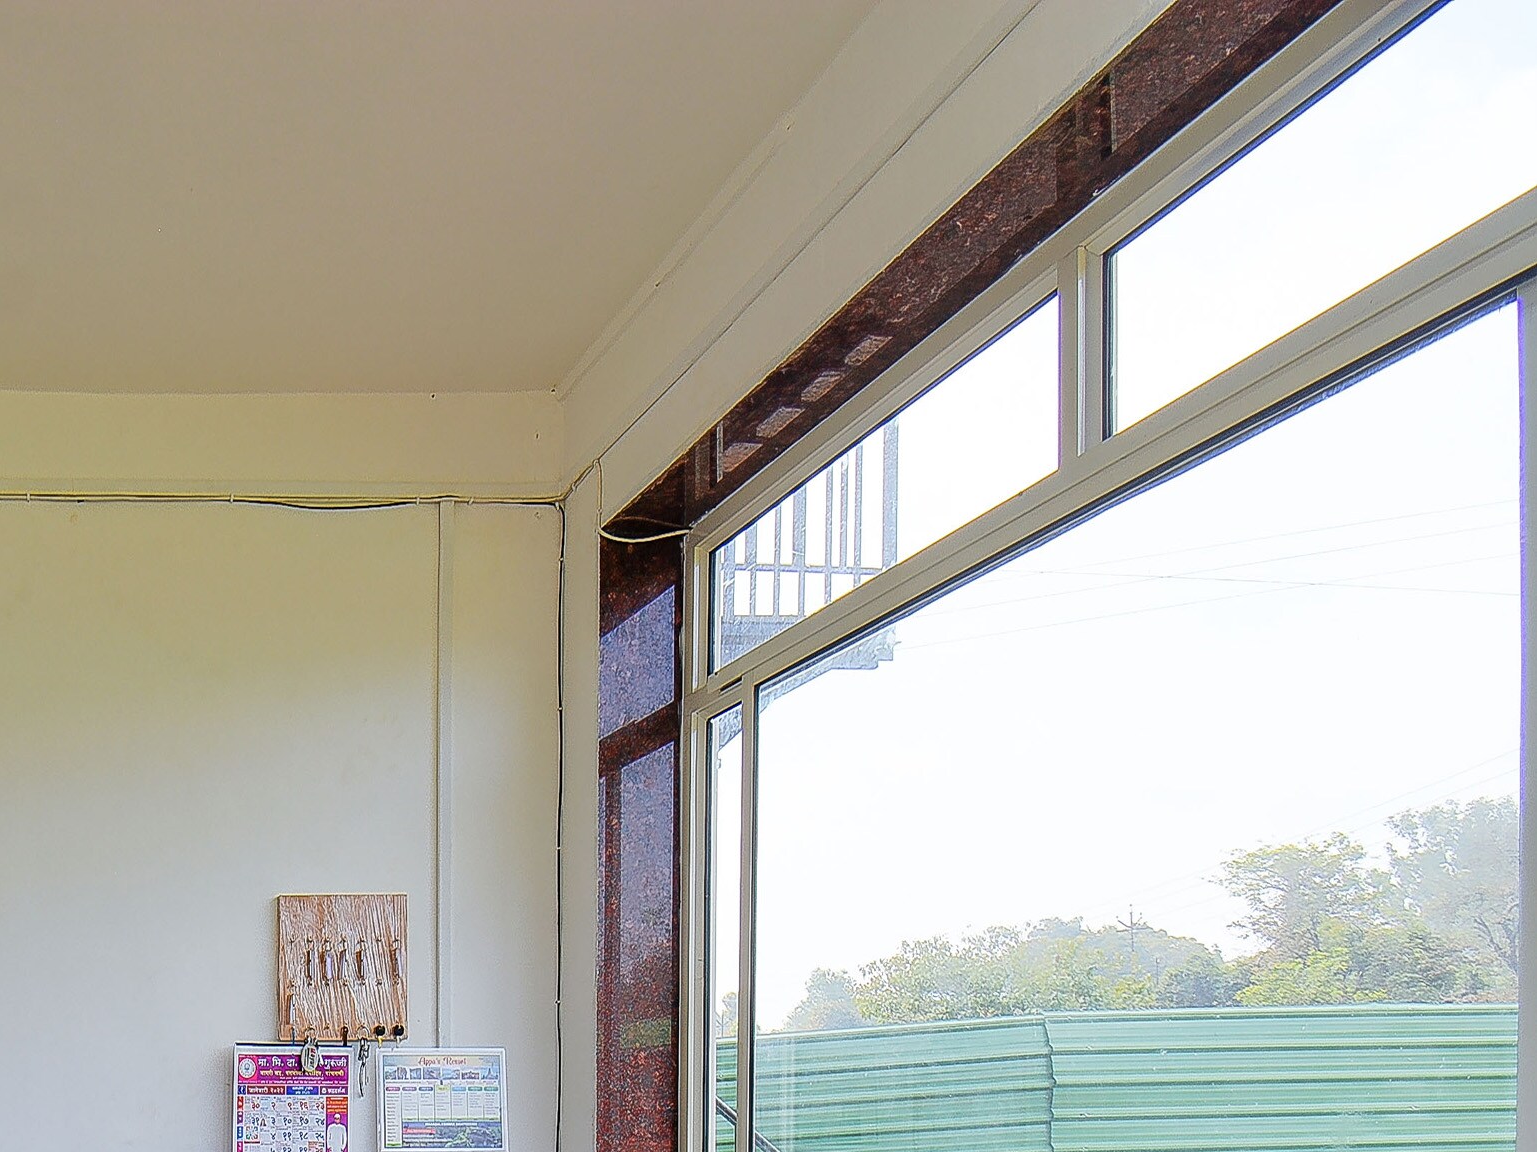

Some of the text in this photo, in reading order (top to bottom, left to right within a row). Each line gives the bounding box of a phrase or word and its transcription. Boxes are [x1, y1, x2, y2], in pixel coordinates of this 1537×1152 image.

[252, 1102, 260, 1110] ३०
[271, 1102, 276, 1110] २
[300, 1102, 309, 1110] १६
[252, 1117, 325, 1126] ३१ ३ १० १७ २४
[283, 1132, 292, 1140] ११
[299, 1132, 308, 1140] १८
